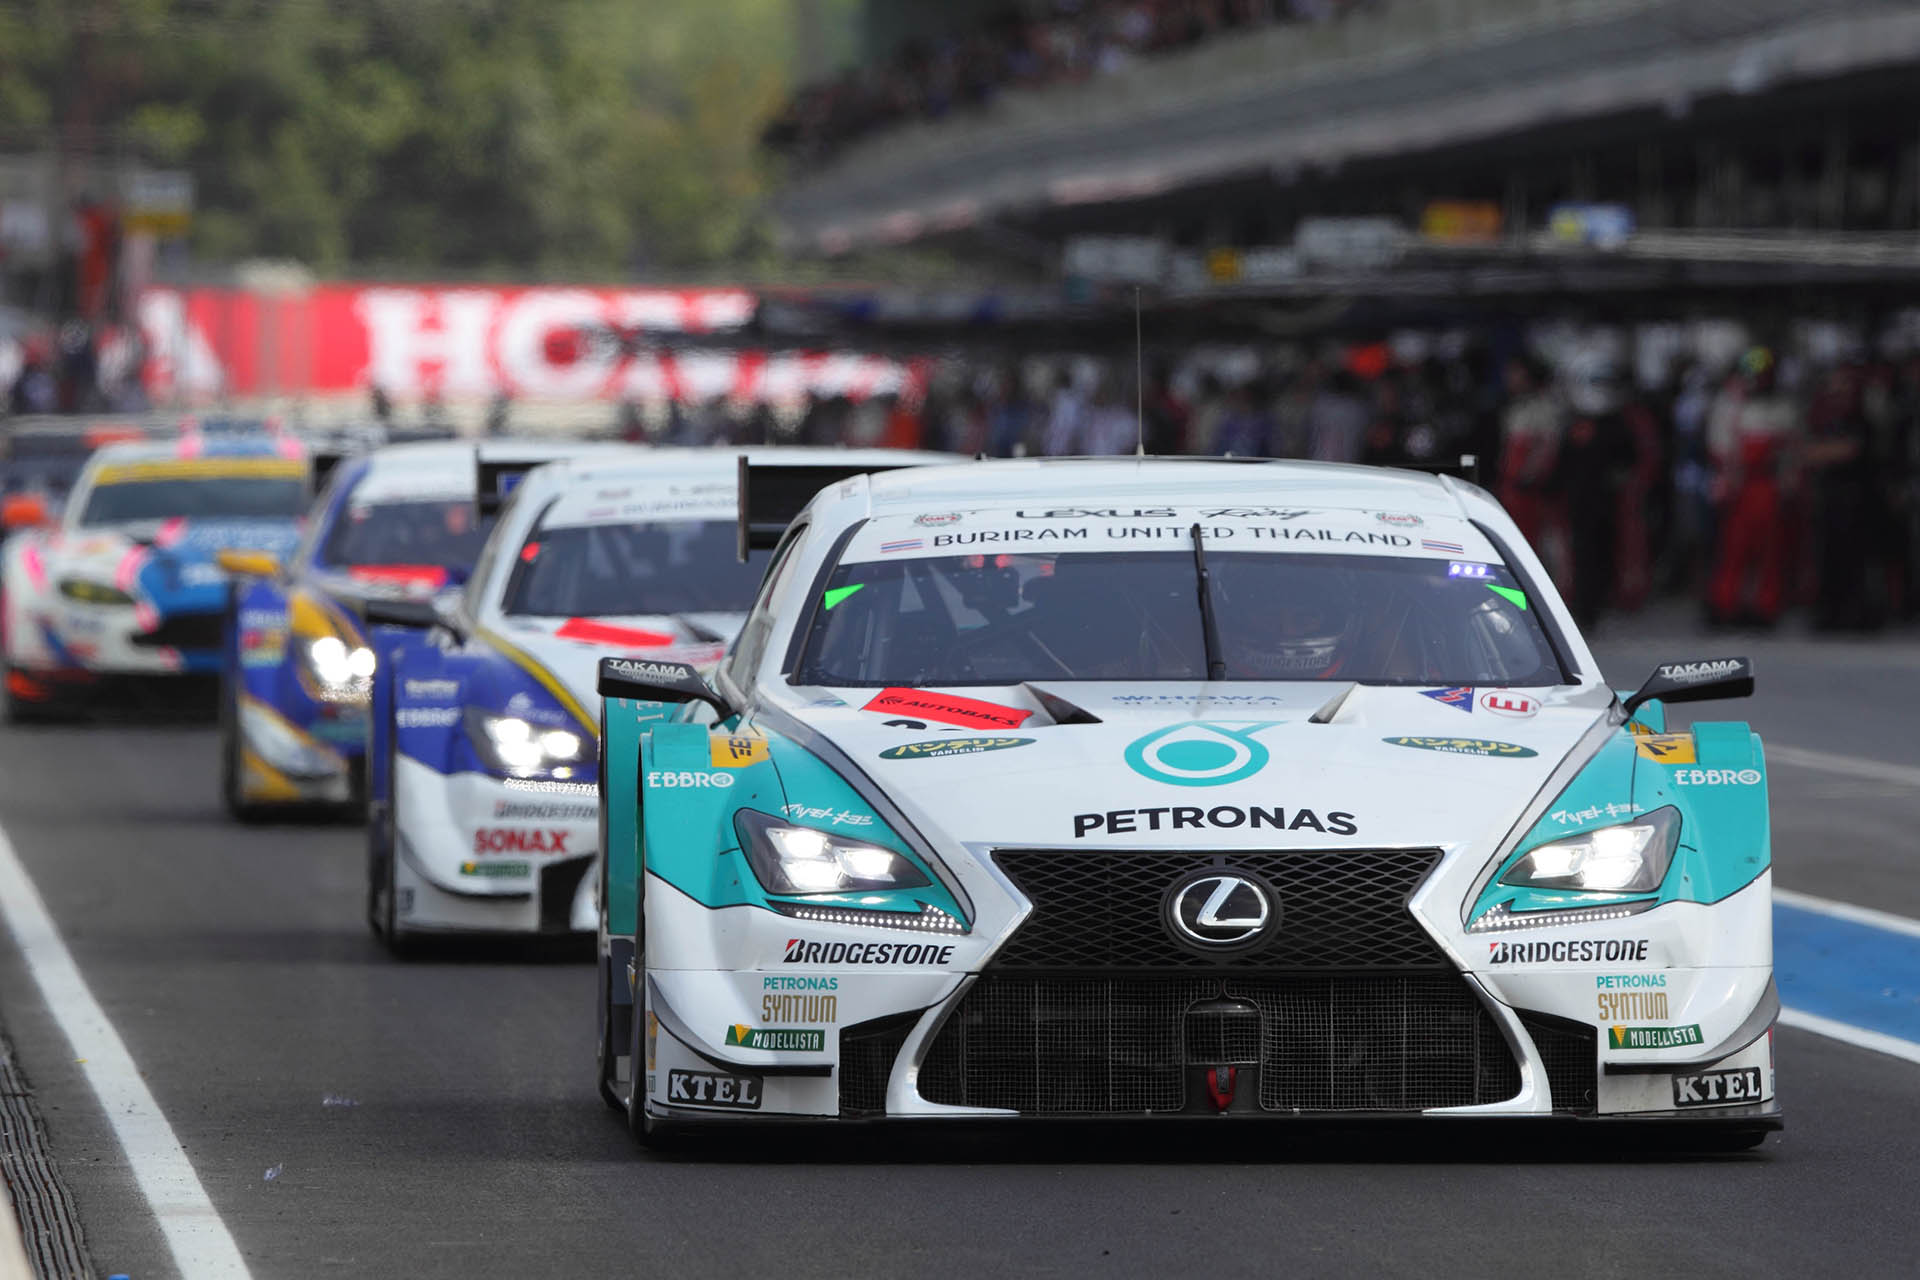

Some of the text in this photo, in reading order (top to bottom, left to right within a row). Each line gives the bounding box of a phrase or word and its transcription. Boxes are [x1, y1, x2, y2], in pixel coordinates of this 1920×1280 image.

[1015, 509, 1176, 518] LEXUS
[933, 526, 1411, 548] BURIRAM UNITED THAILAND
[609, 659, 690, 677] TAKAMA
[1660, 659, 1742, 677] TAKAMA
[903, 700, 1019, 726] AUTOBACS
[895, 738, 1020, 756] バンテリン
[930, 746, 986, 757] VANTELIN
[1398, 737, 1522, 753] バンテリン
[1434, 746, 1489, 756] VANTELIN
[648, 772, 734, 788] EBBRO
[1674, 769, 1762, 785] EBBRO
[1075, 806, 1358, 838] PETRONAS
[784, 939, 955, 964] BRIDGESTONE
[1489, 939, 1649, 964] BRIDGESTONE
[763, 977, 838, 991] PETRONAS
[1597, 975, 1667, 989] PETRONAS
[762, 994, 837, 1023] SYNTIUM
[1599, 992, 1669, 1020] SYNTIUM
[752, 1033, 819, 1049] MODELLISTA
[1630, 1028, 1697, 1047] MODELLISTA
[670, 1073, 758, 1104] KTEL
[1677, 1071, 1761, 1102] KTEL
